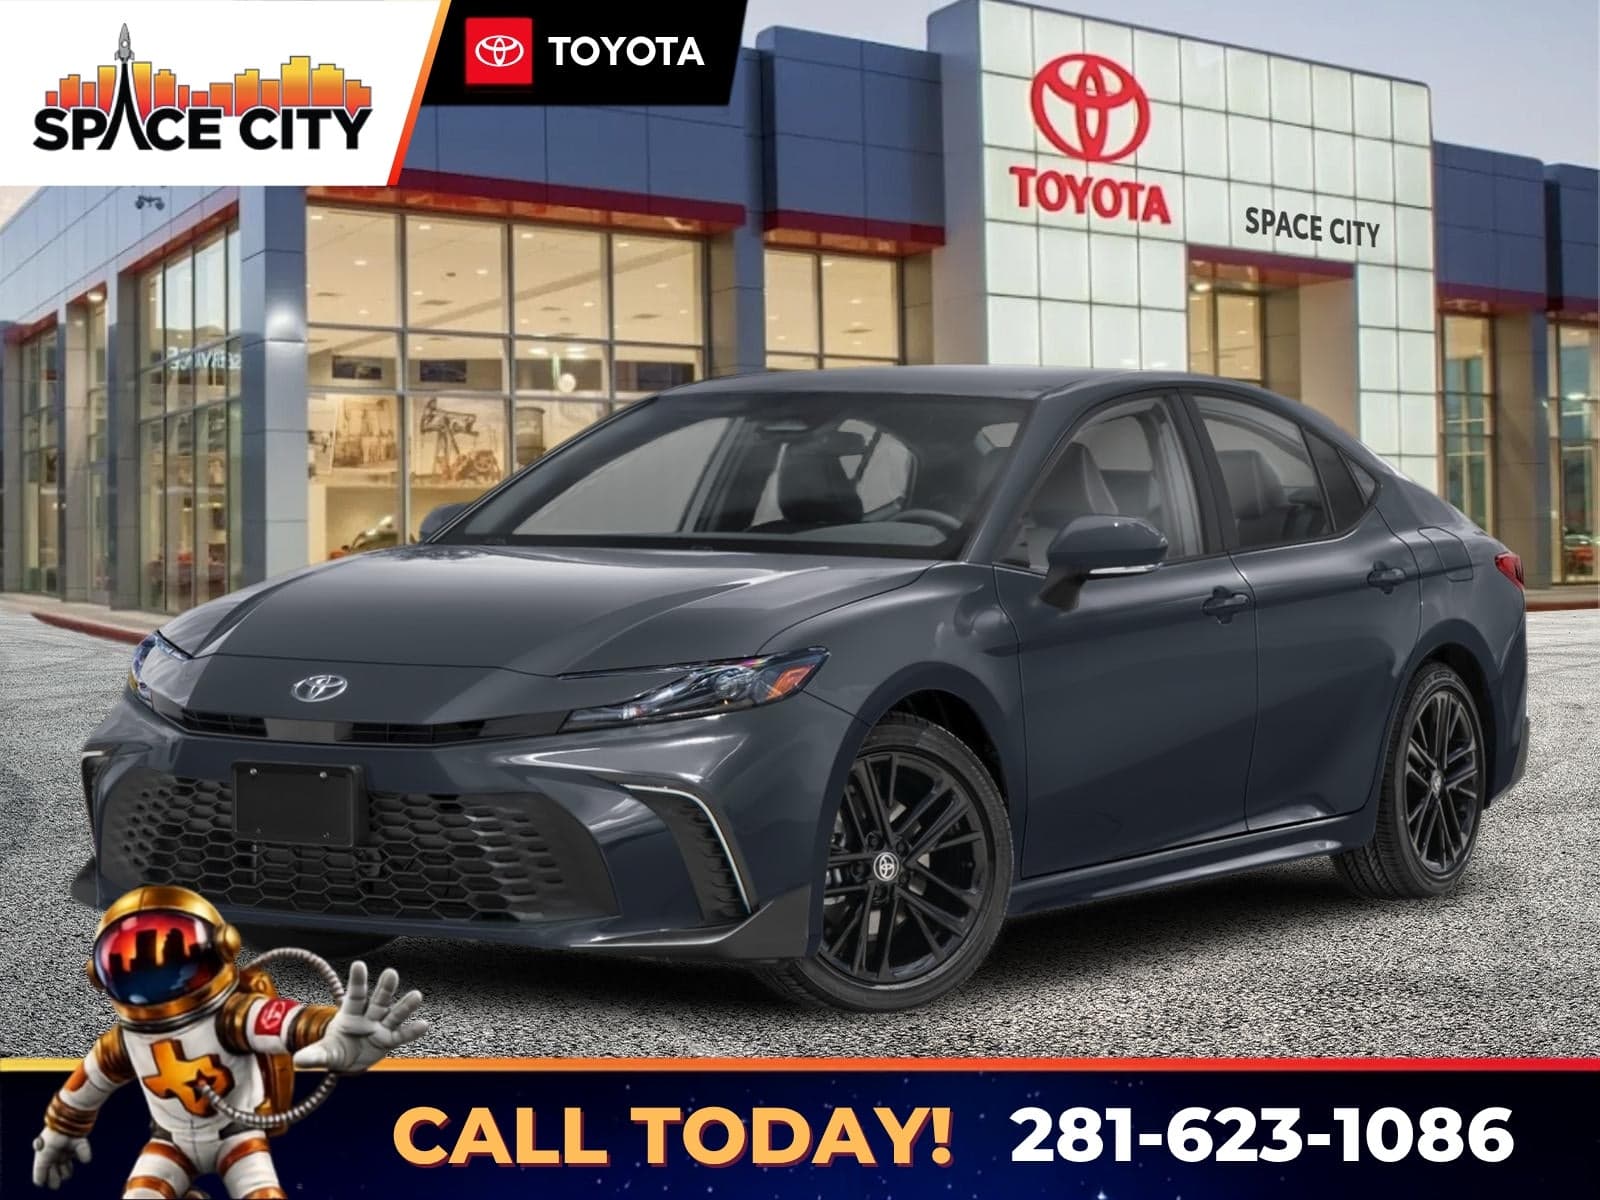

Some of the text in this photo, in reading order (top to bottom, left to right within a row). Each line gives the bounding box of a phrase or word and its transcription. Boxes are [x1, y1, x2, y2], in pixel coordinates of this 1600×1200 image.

[1008, 166, 1172, 225] TOYOTA
[1245, 206, 1381, 249] SPACE CITY
